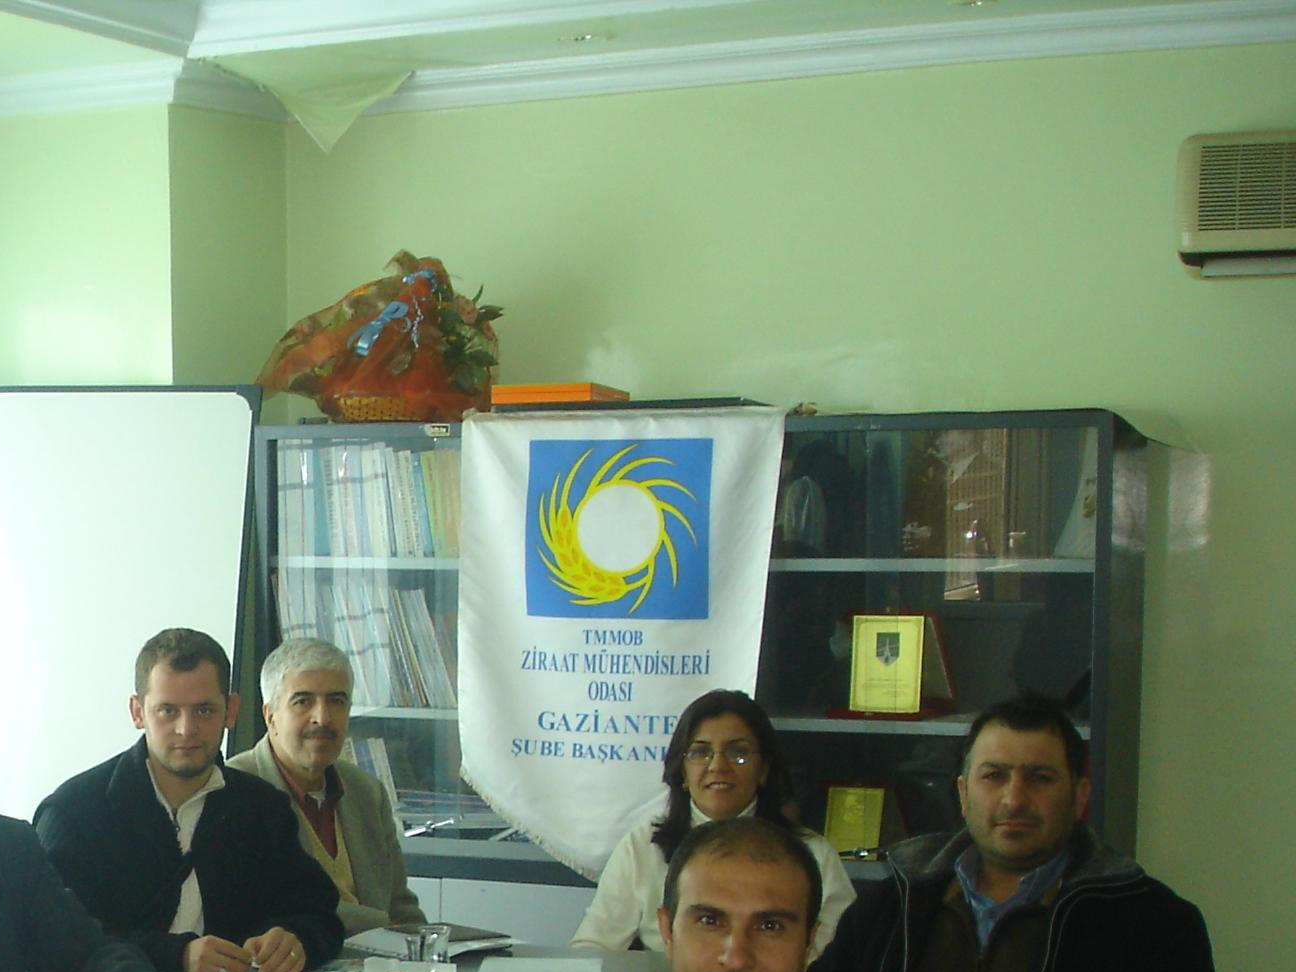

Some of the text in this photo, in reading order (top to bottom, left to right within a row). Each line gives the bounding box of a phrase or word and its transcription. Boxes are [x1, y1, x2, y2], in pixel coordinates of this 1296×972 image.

[582, 629, 644, 646] TMMOB
[520, 646, 711, 676] ZİRAAT MÜHENDİSLERİ
[587, 680, 633, 702] ODASI
[537, 709, 678, 735] GAZİANTE
[510, 738, 667, 764] ŞUBE BAŞKAN
